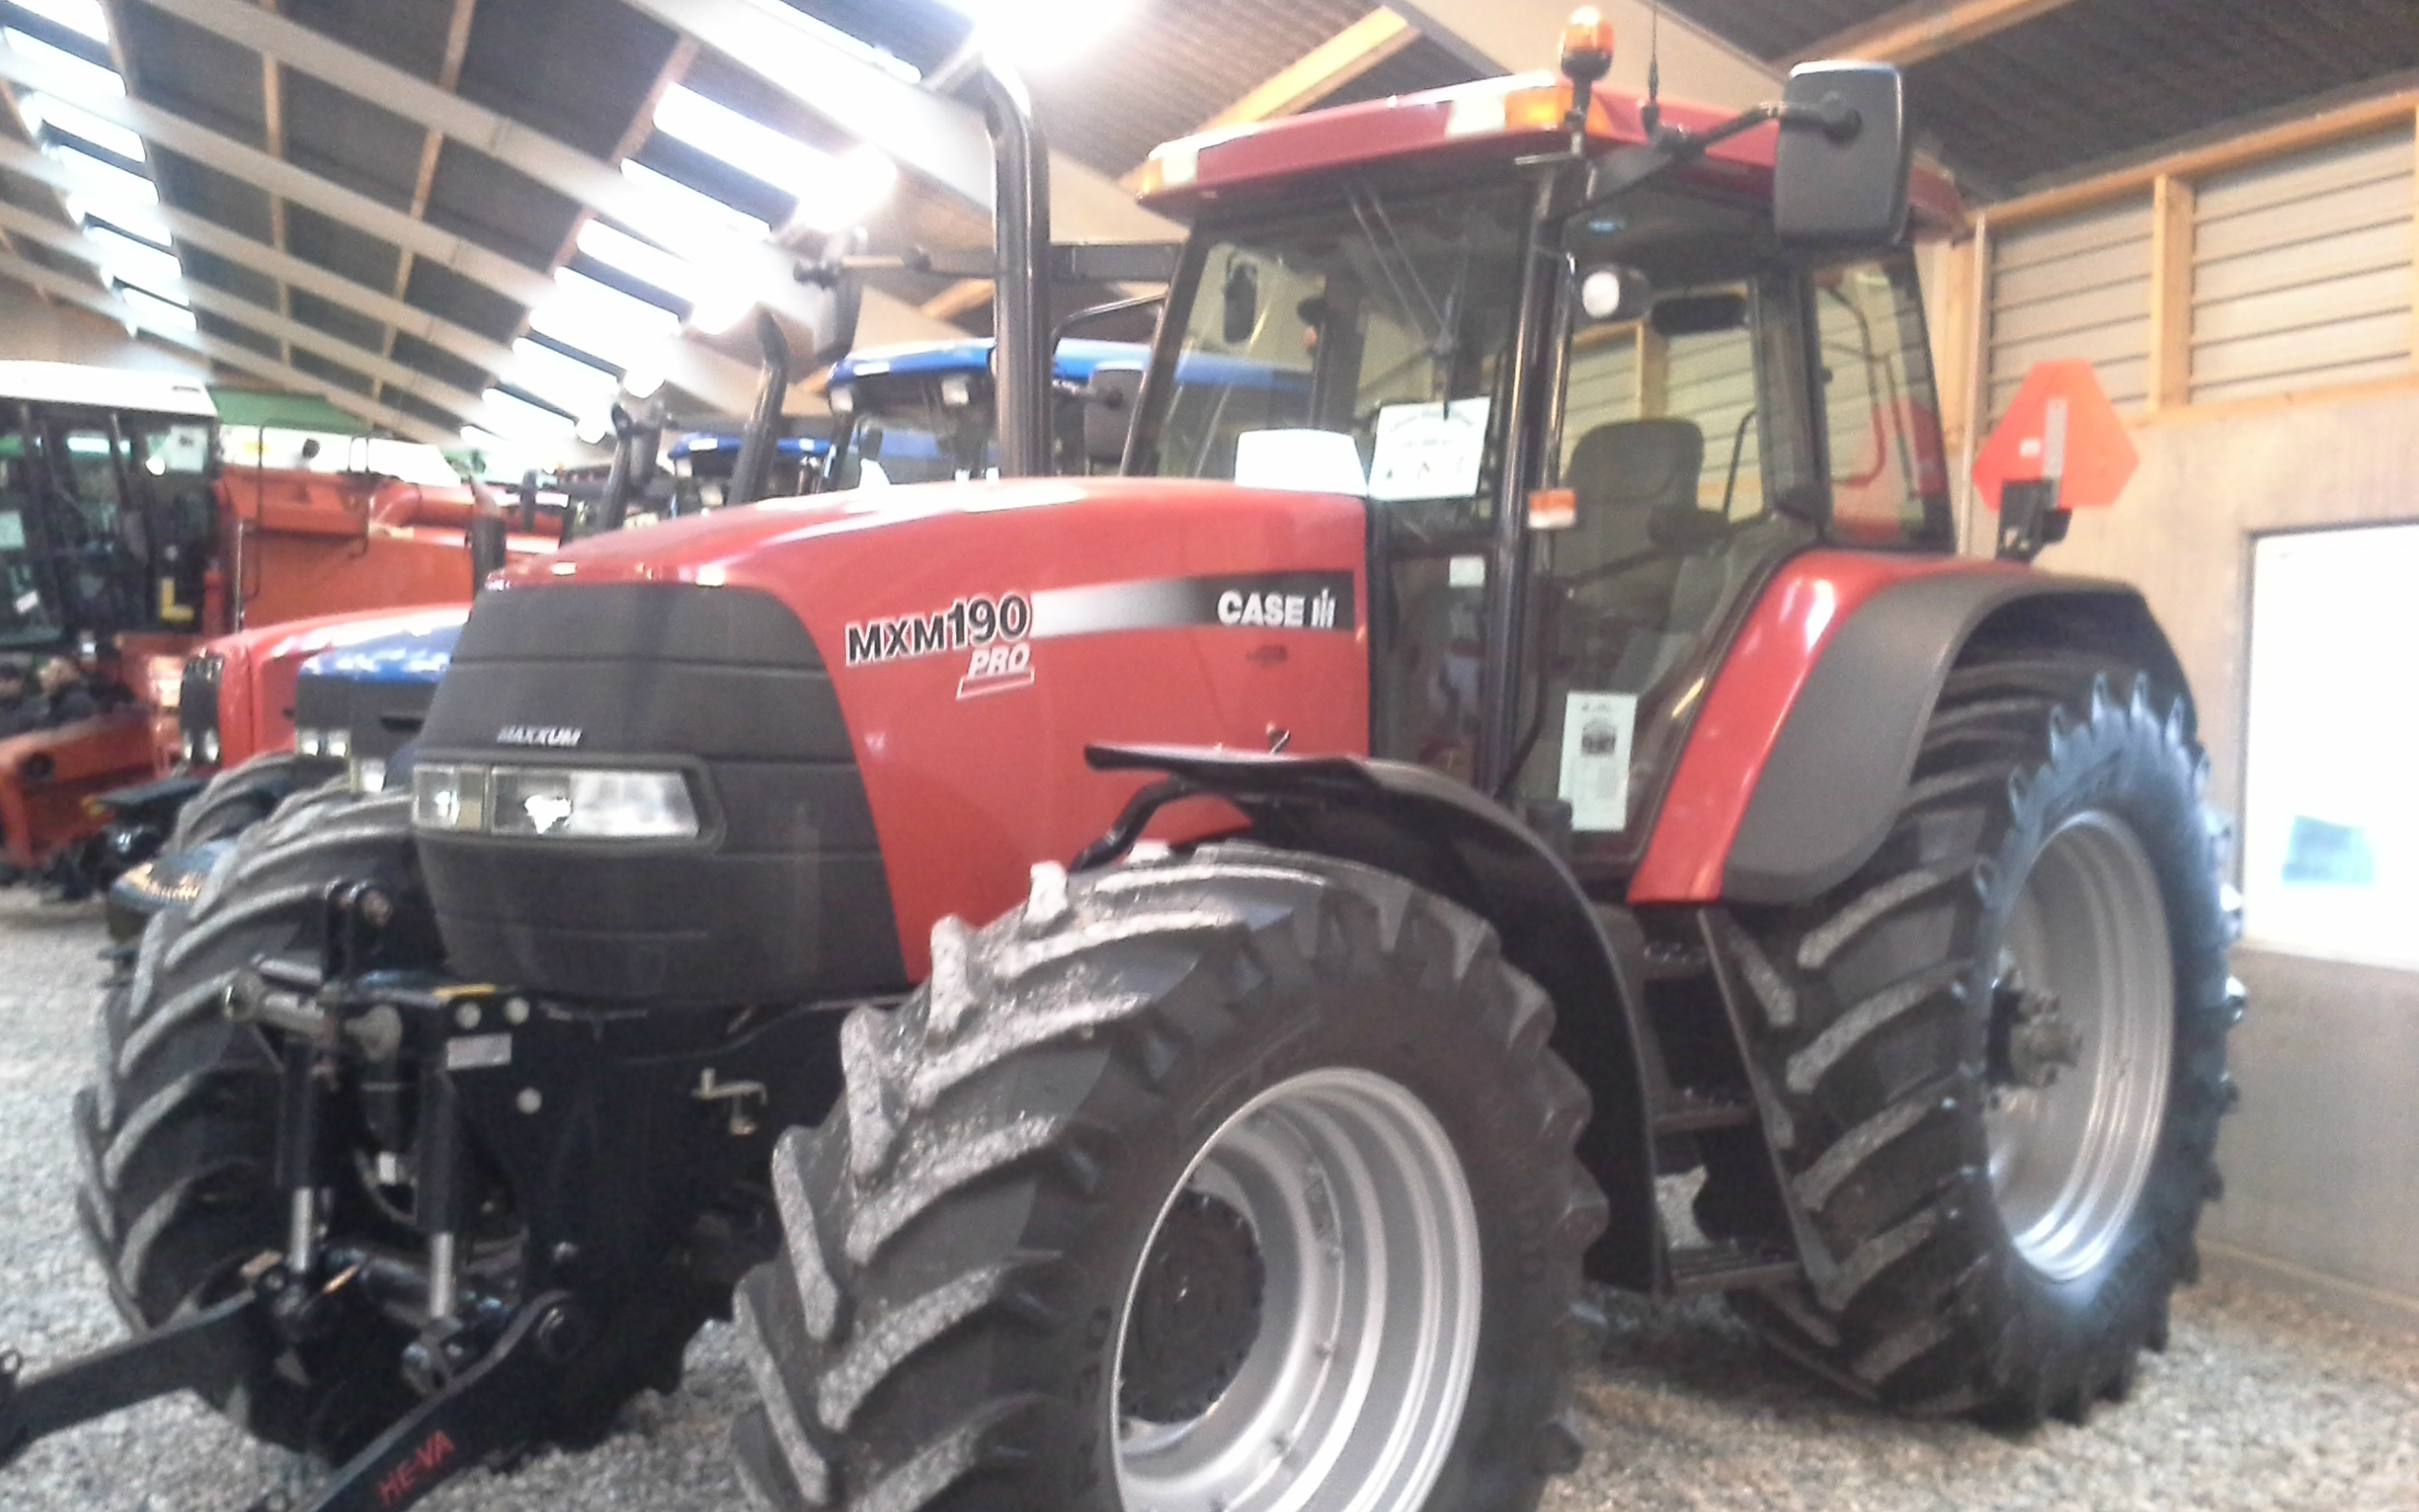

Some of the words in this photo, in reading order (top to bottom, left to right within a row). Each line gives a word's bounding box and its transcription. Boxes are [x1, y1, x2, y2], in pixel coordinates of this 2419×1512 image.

[1217, 590, 1304, 627] CASE
[967, 645, 1031, 680] PRO
[496, 725, 582, 747] MAXXUM
[379, 1430, 454, 1508] HE-VA
